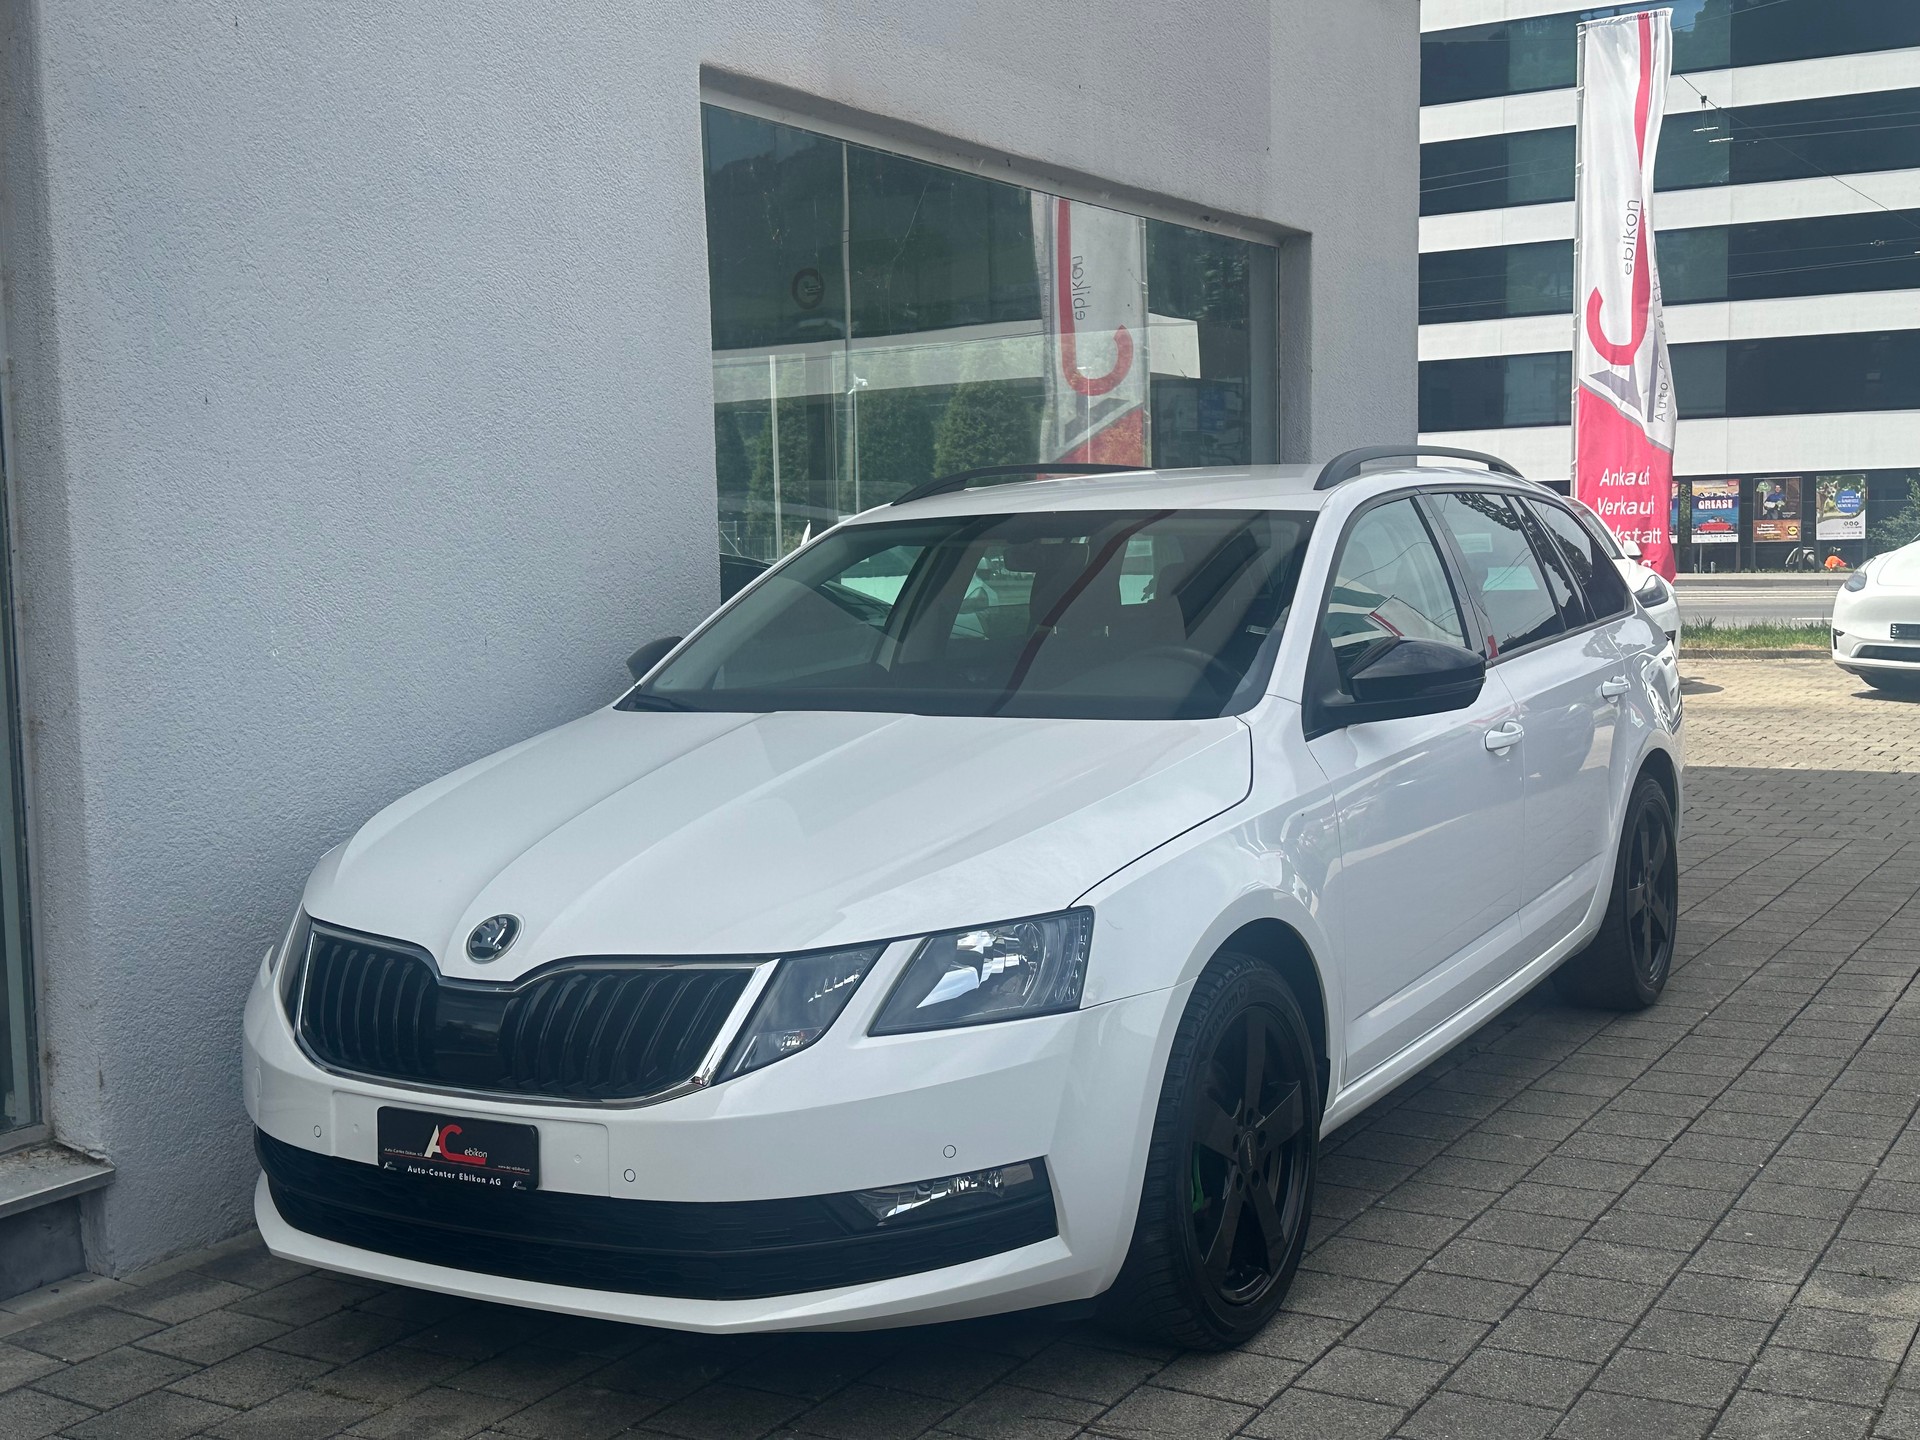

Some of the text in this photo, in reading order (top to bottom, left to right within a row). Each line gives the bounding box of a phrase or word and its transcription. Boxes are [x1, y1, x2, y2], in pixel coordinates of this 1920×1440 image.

[1623, 199, 1640, 275] ebikon
[1599, 465, 1650, 487] Ankauf
[1597, 494, 1655, 515] Verkauf
[1613, 524, 1662, 544] kstatt
[423, 1124, 488, 1165] AC
[464, 1147, 488, 1158] ebikon
[407, 1165, 502, 1186] Auto-Center Ebikon AG
